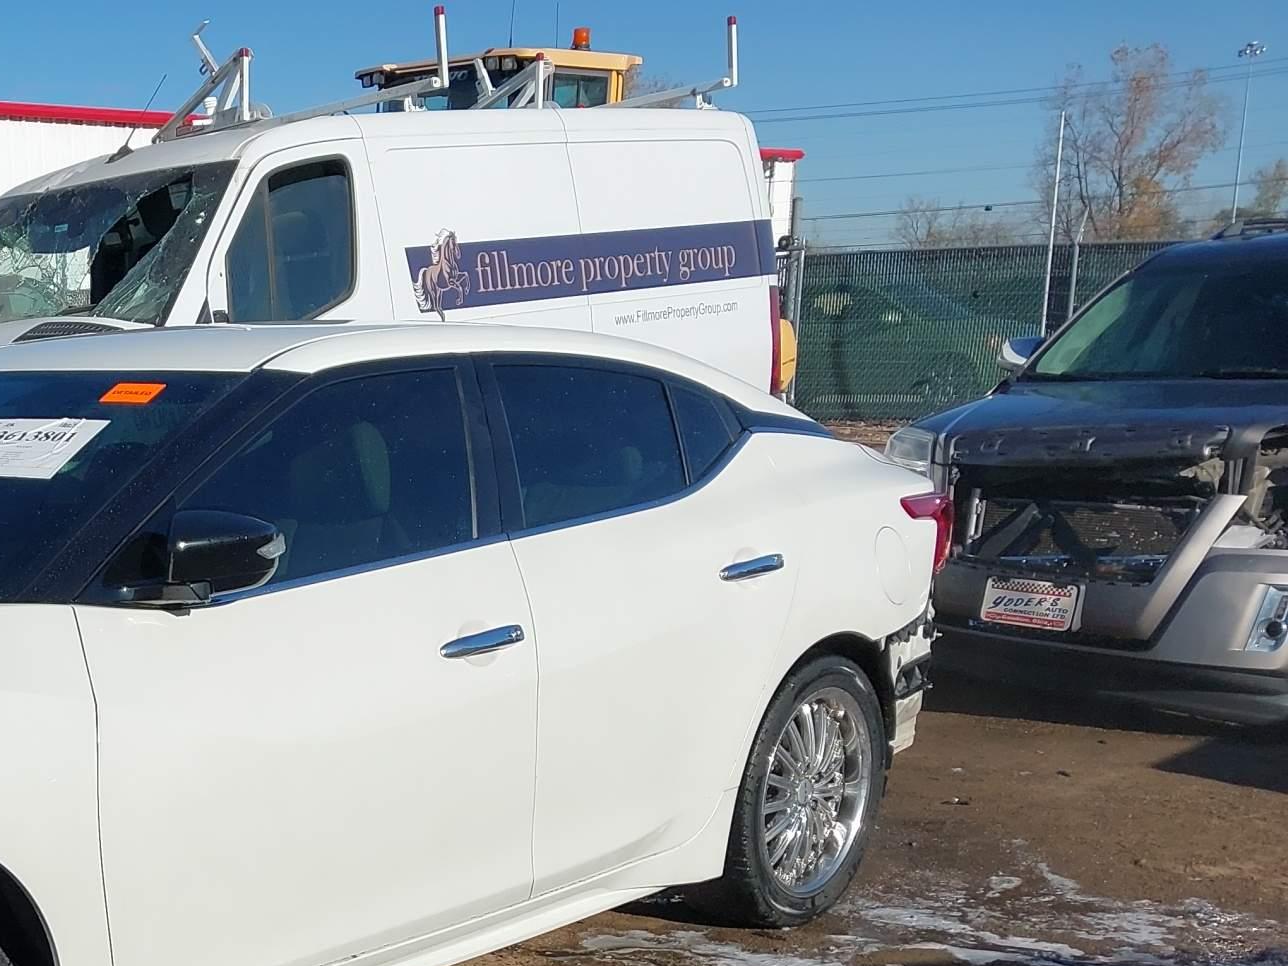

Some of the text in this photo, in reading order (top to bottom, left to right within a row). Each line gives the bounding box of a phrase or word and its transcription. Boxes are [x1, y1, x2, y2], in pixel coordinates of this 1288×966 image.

[475, 244, 736, 292] fillmore property group
[614, 300, 738, 326] www.FillmorePropertyGroup.com
[987, 595, 1062, 610] YODER'S
[1003, 607, 1050, 618] CONNECTION
